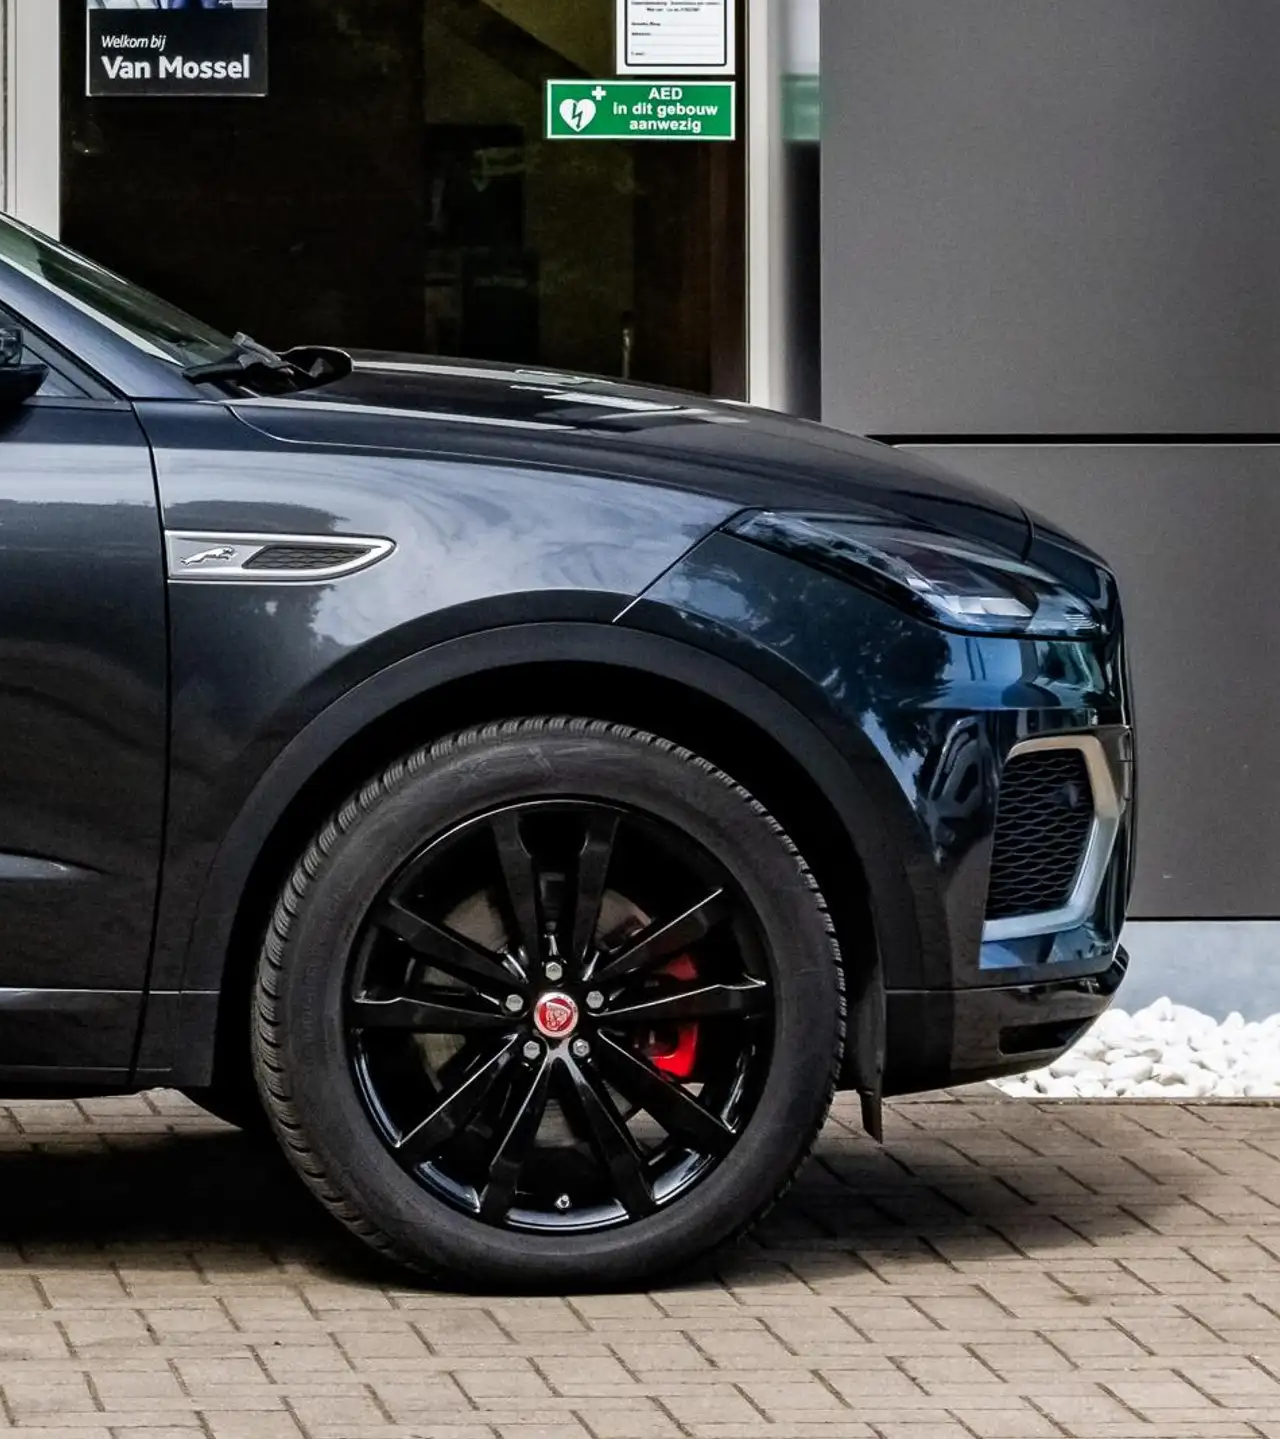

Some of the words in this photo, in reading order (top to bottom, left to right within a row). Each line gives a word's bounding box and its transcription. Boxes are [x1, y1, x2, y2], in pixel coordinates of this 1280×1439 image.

[101, 35, 149, 48] Welkom
[150, 35, 167, 51] bij
[101, 56, 152, 79] Van
[158, 54, 251, 79] Mossel
[649, 87, 682, 100] AED
[632, 102, 652, 114] dit
[657, 102, 718, 116] gebouw
[629, 118, 701, 132] aanwezig
